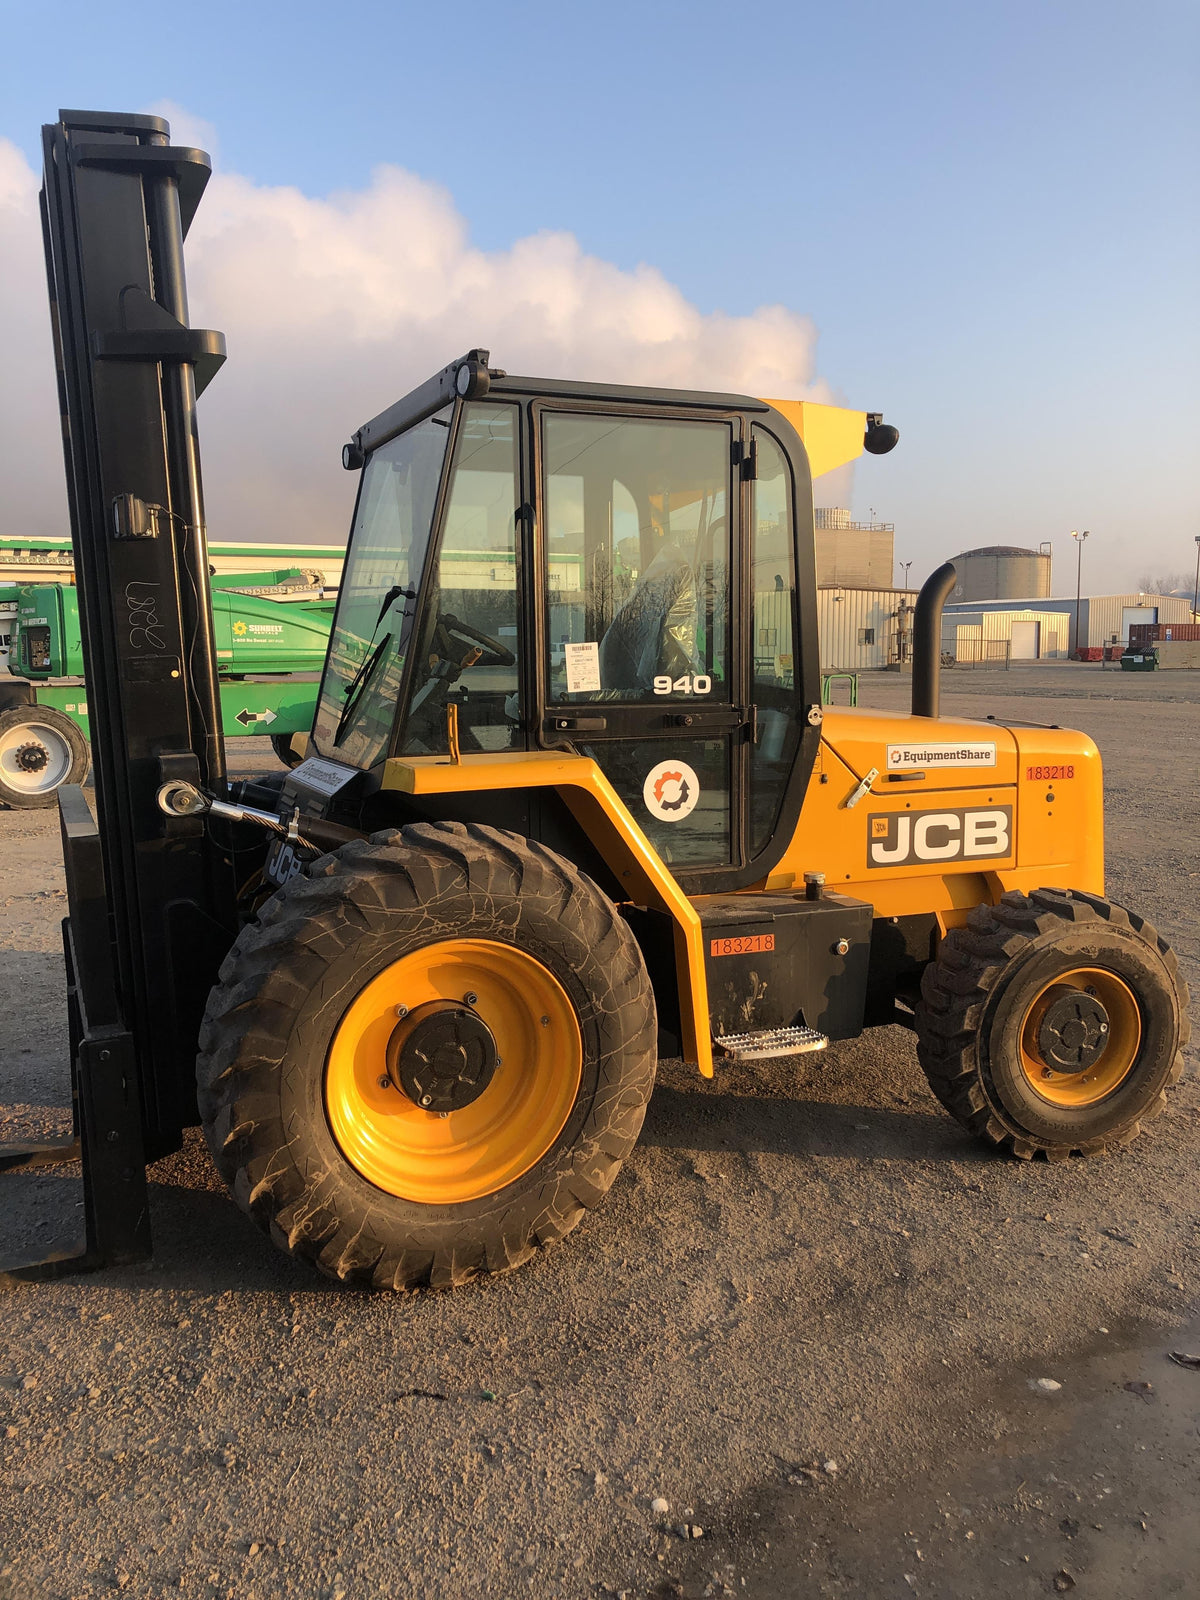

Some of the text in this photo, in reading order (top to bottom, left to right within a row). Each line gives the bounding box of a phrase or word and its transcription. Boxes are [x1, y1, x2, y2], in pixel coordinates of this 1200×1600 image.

[653, 675, 712, 695] 940
[903, 749, 991, 763] EquipmentShare
[1027, 765, 1075, 780] 183218
[871, 810, 1009, 864] JCB
[713, 935, 773, 954] 183218
